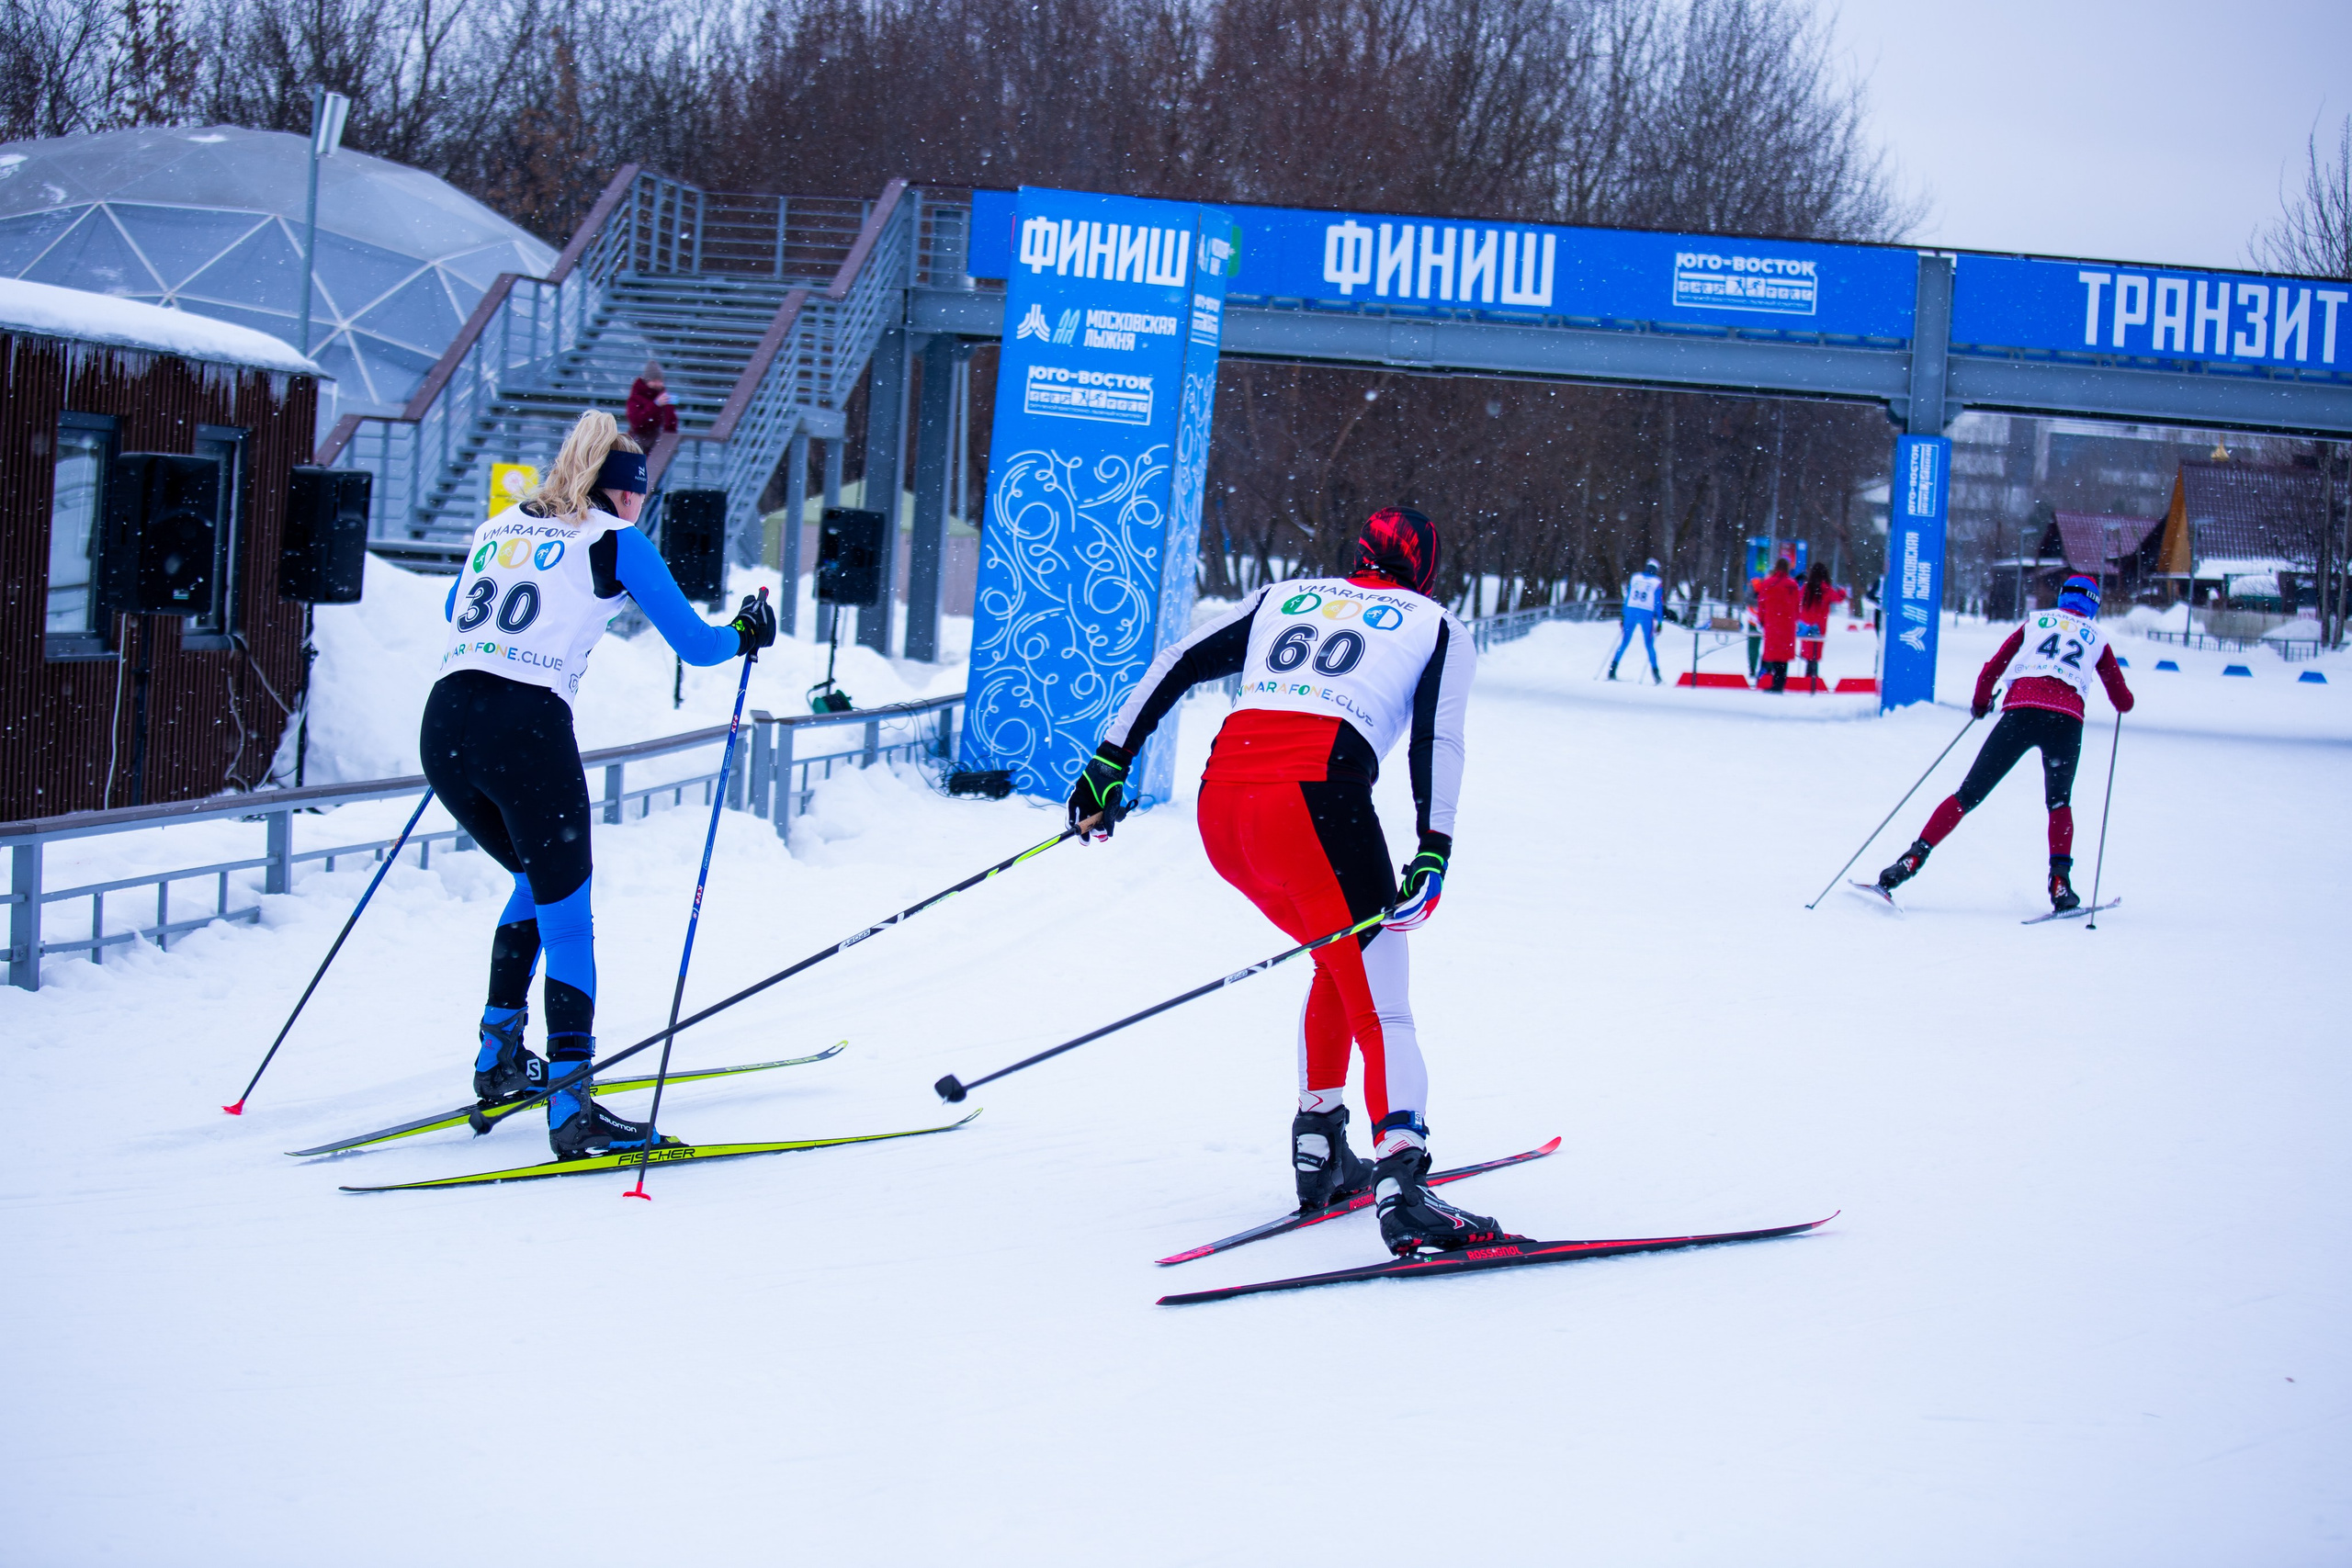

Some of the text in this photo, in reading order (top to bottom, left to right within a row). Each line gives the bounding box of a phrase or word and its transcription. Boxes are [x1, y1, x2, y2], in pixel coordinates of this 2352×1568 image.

[1020, 216, 1191, 288] ФИНИШ
[1323, 220, 1556, 307] ФИНИШ
[1676, 253, 1817, 276] ЮГО-ВОСТОК
[1086, 309, 1177, 336] МОСКОВСКАЯ
[2078, 270, 2349, 364] ТРАНЗИТ
[1083, 328, 1136, 351] ЛЫЖНЯ
[1028, 365, 1154, 391] ЮГО-ВОСТОК
[1908, 444, 1919, 515] ЮГО-ВОСТОК
[482, 524, 581, 541] VMARAFONE
[1902, 531, 1919, 599] МОСКОВСКАЯ
[1917, 561, 1931, 601] ЛЫЖНЯ
[457, 576, 541, 635] 30
[1298, 584, 1418, 613] VMARAFONE
[443, 641, 563, 671] VARAFONE.CLUB
[1266, 623, 1366, 677] 60
[2036, 632, 2085, 671] 42
[617, 1147, 695, 1166] FISCHER
[1466, 1246, 1523, 1260] ROSSIGNOL
